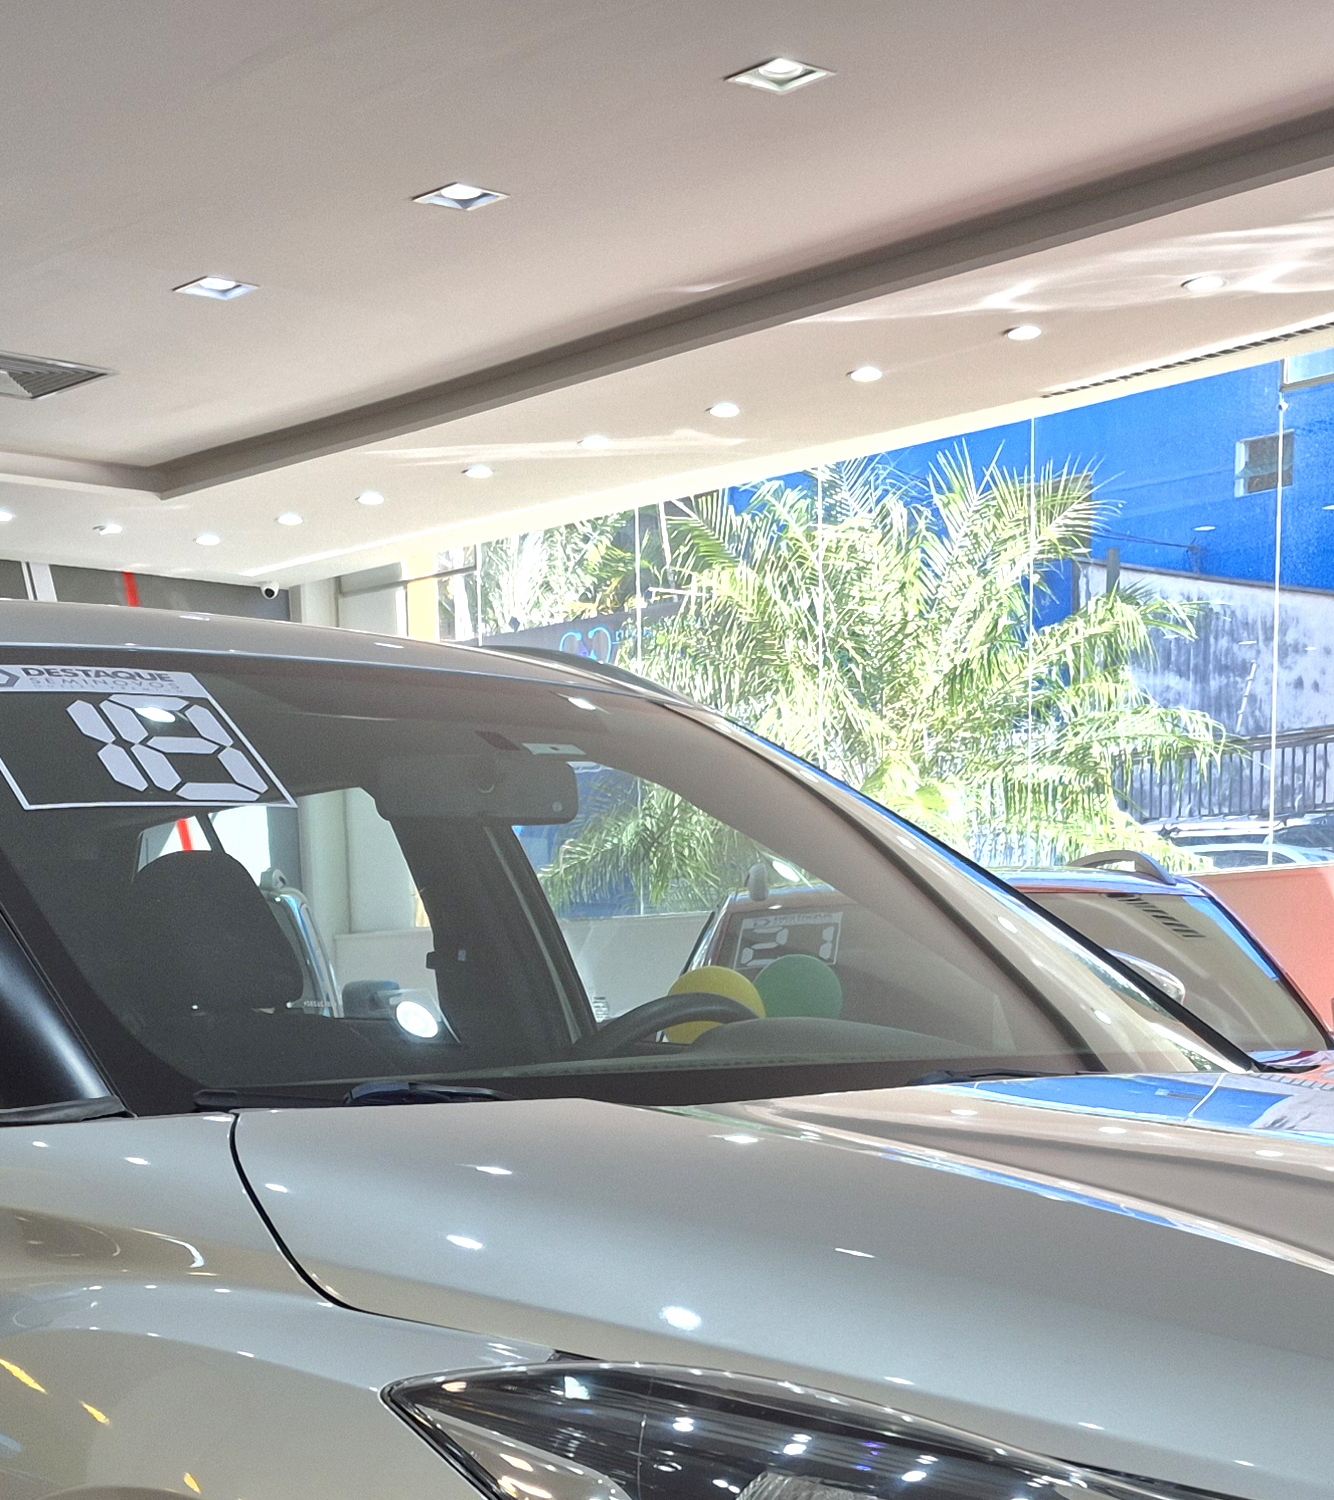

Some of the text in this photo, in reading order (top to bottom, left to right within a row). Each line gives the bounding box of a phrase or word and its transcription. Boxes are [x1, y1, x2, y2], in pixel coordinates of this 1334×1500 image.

[21, 667, 174, 682] DESTAQUE
[29, 677, 180, 690] SEMINOVOS
[66, 694, 269, 802] 18
